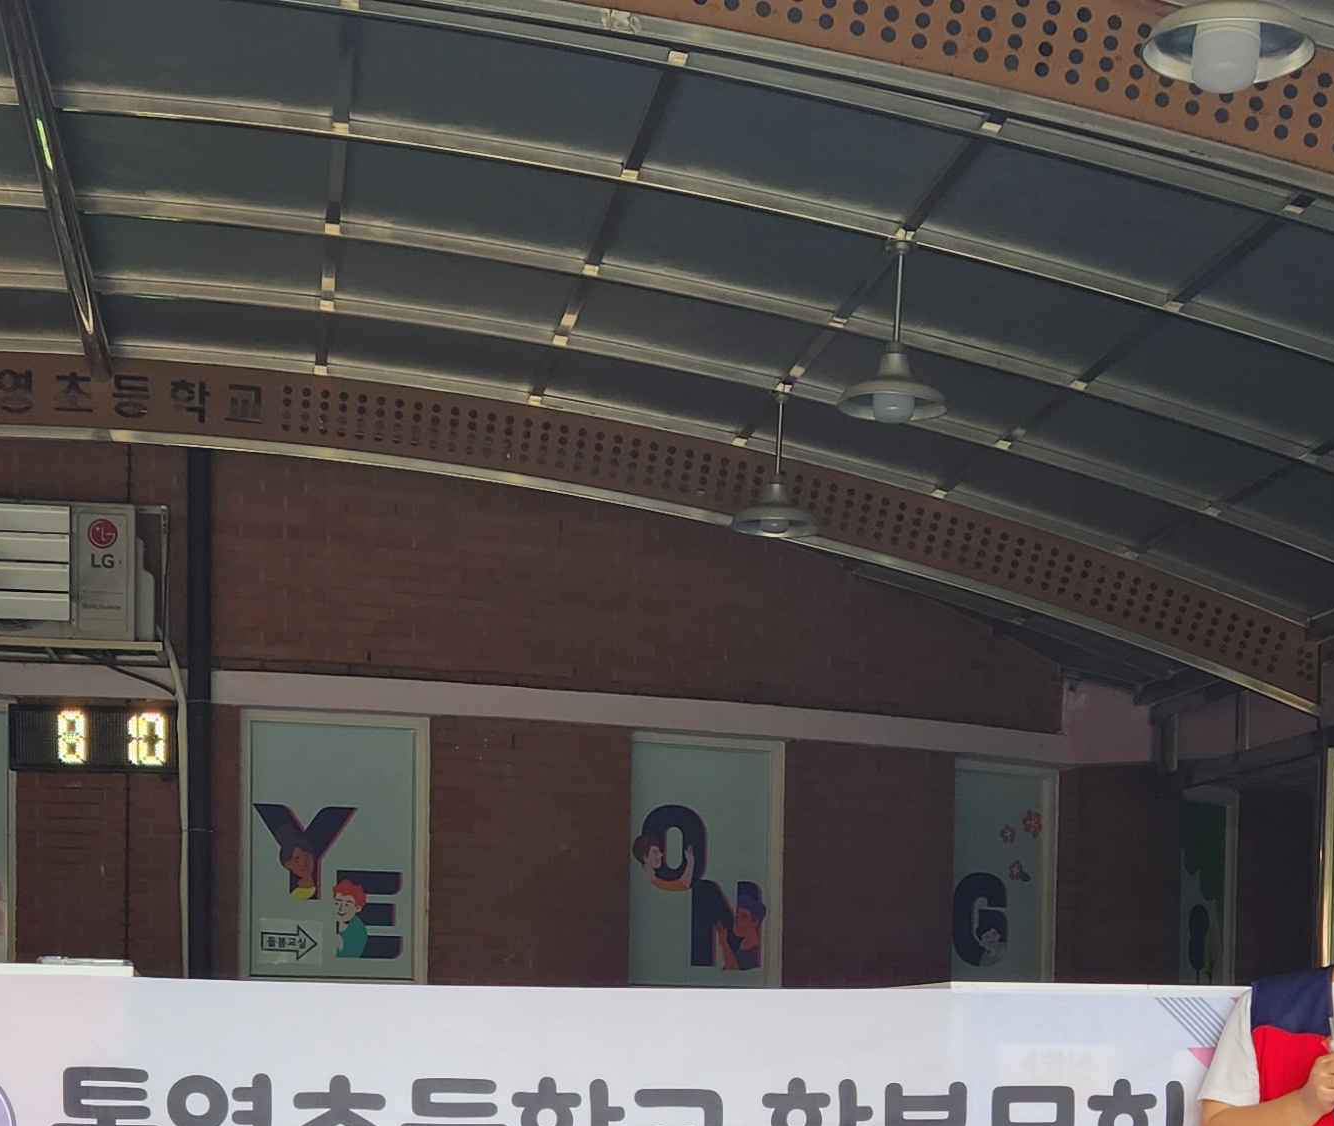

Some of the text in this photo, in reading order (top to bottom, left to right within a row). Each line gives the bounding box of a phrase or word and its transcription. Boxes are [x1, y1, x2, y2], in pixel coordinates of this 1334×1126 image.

[90, 553, 115, 569] LG
[57, 709, 166, 767] 8 10
[253, 803, 359, 900] Y
[641, 804, 707, 886] O
[334, 869, 404, 960] E
[690, 879, 762, 968] N
[953, 872, 1008, 967] G
